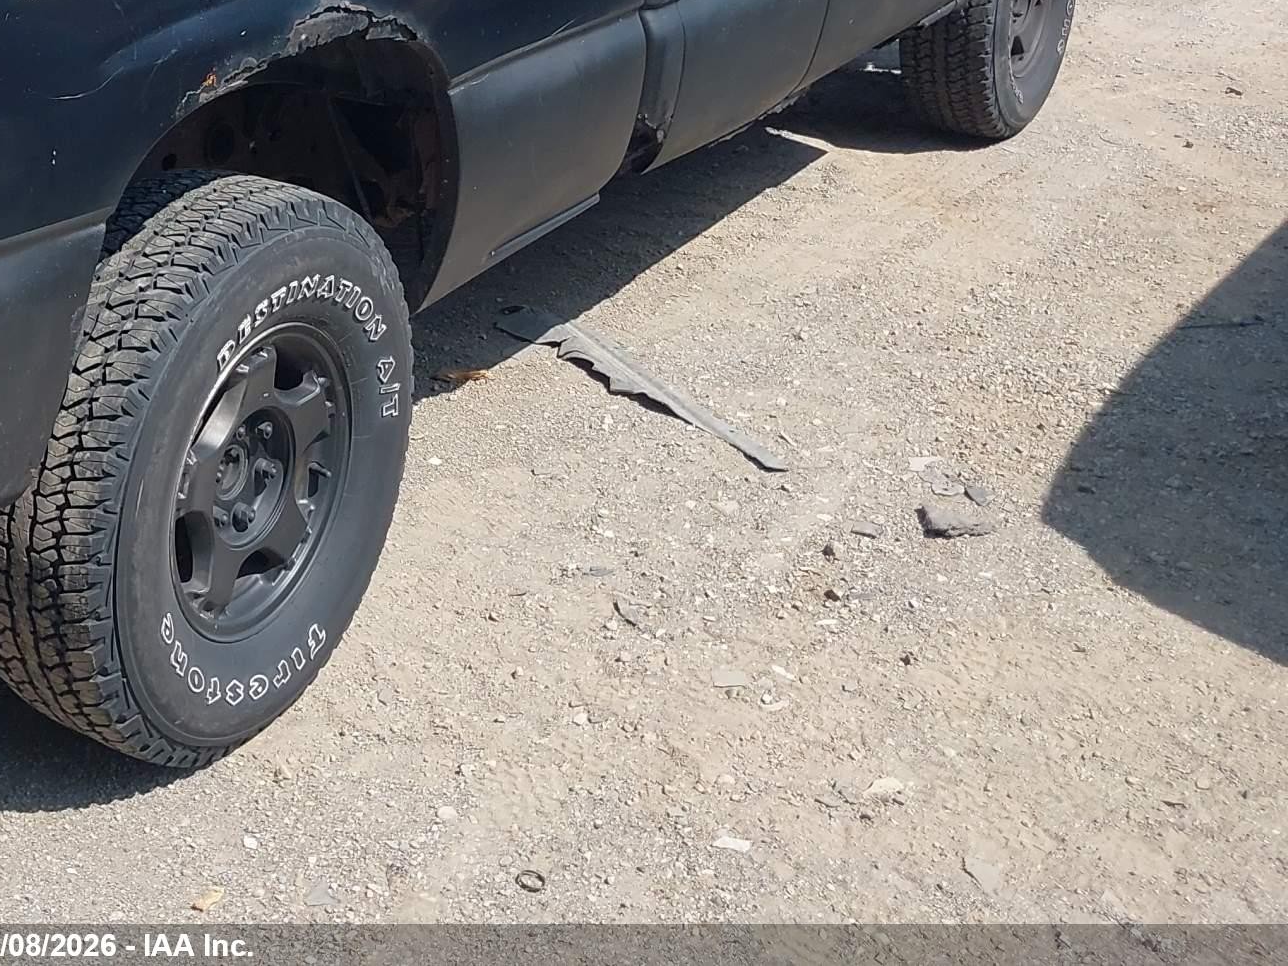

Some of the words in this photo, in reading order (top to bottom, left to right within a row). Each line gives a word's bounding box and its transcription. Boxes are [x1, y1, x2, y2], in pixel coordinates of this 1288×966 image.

[216, 273, 388, 372] DESTINATION
[375, 355, 401, 418] A/T
[161, 612, 328, 707] Firestone
